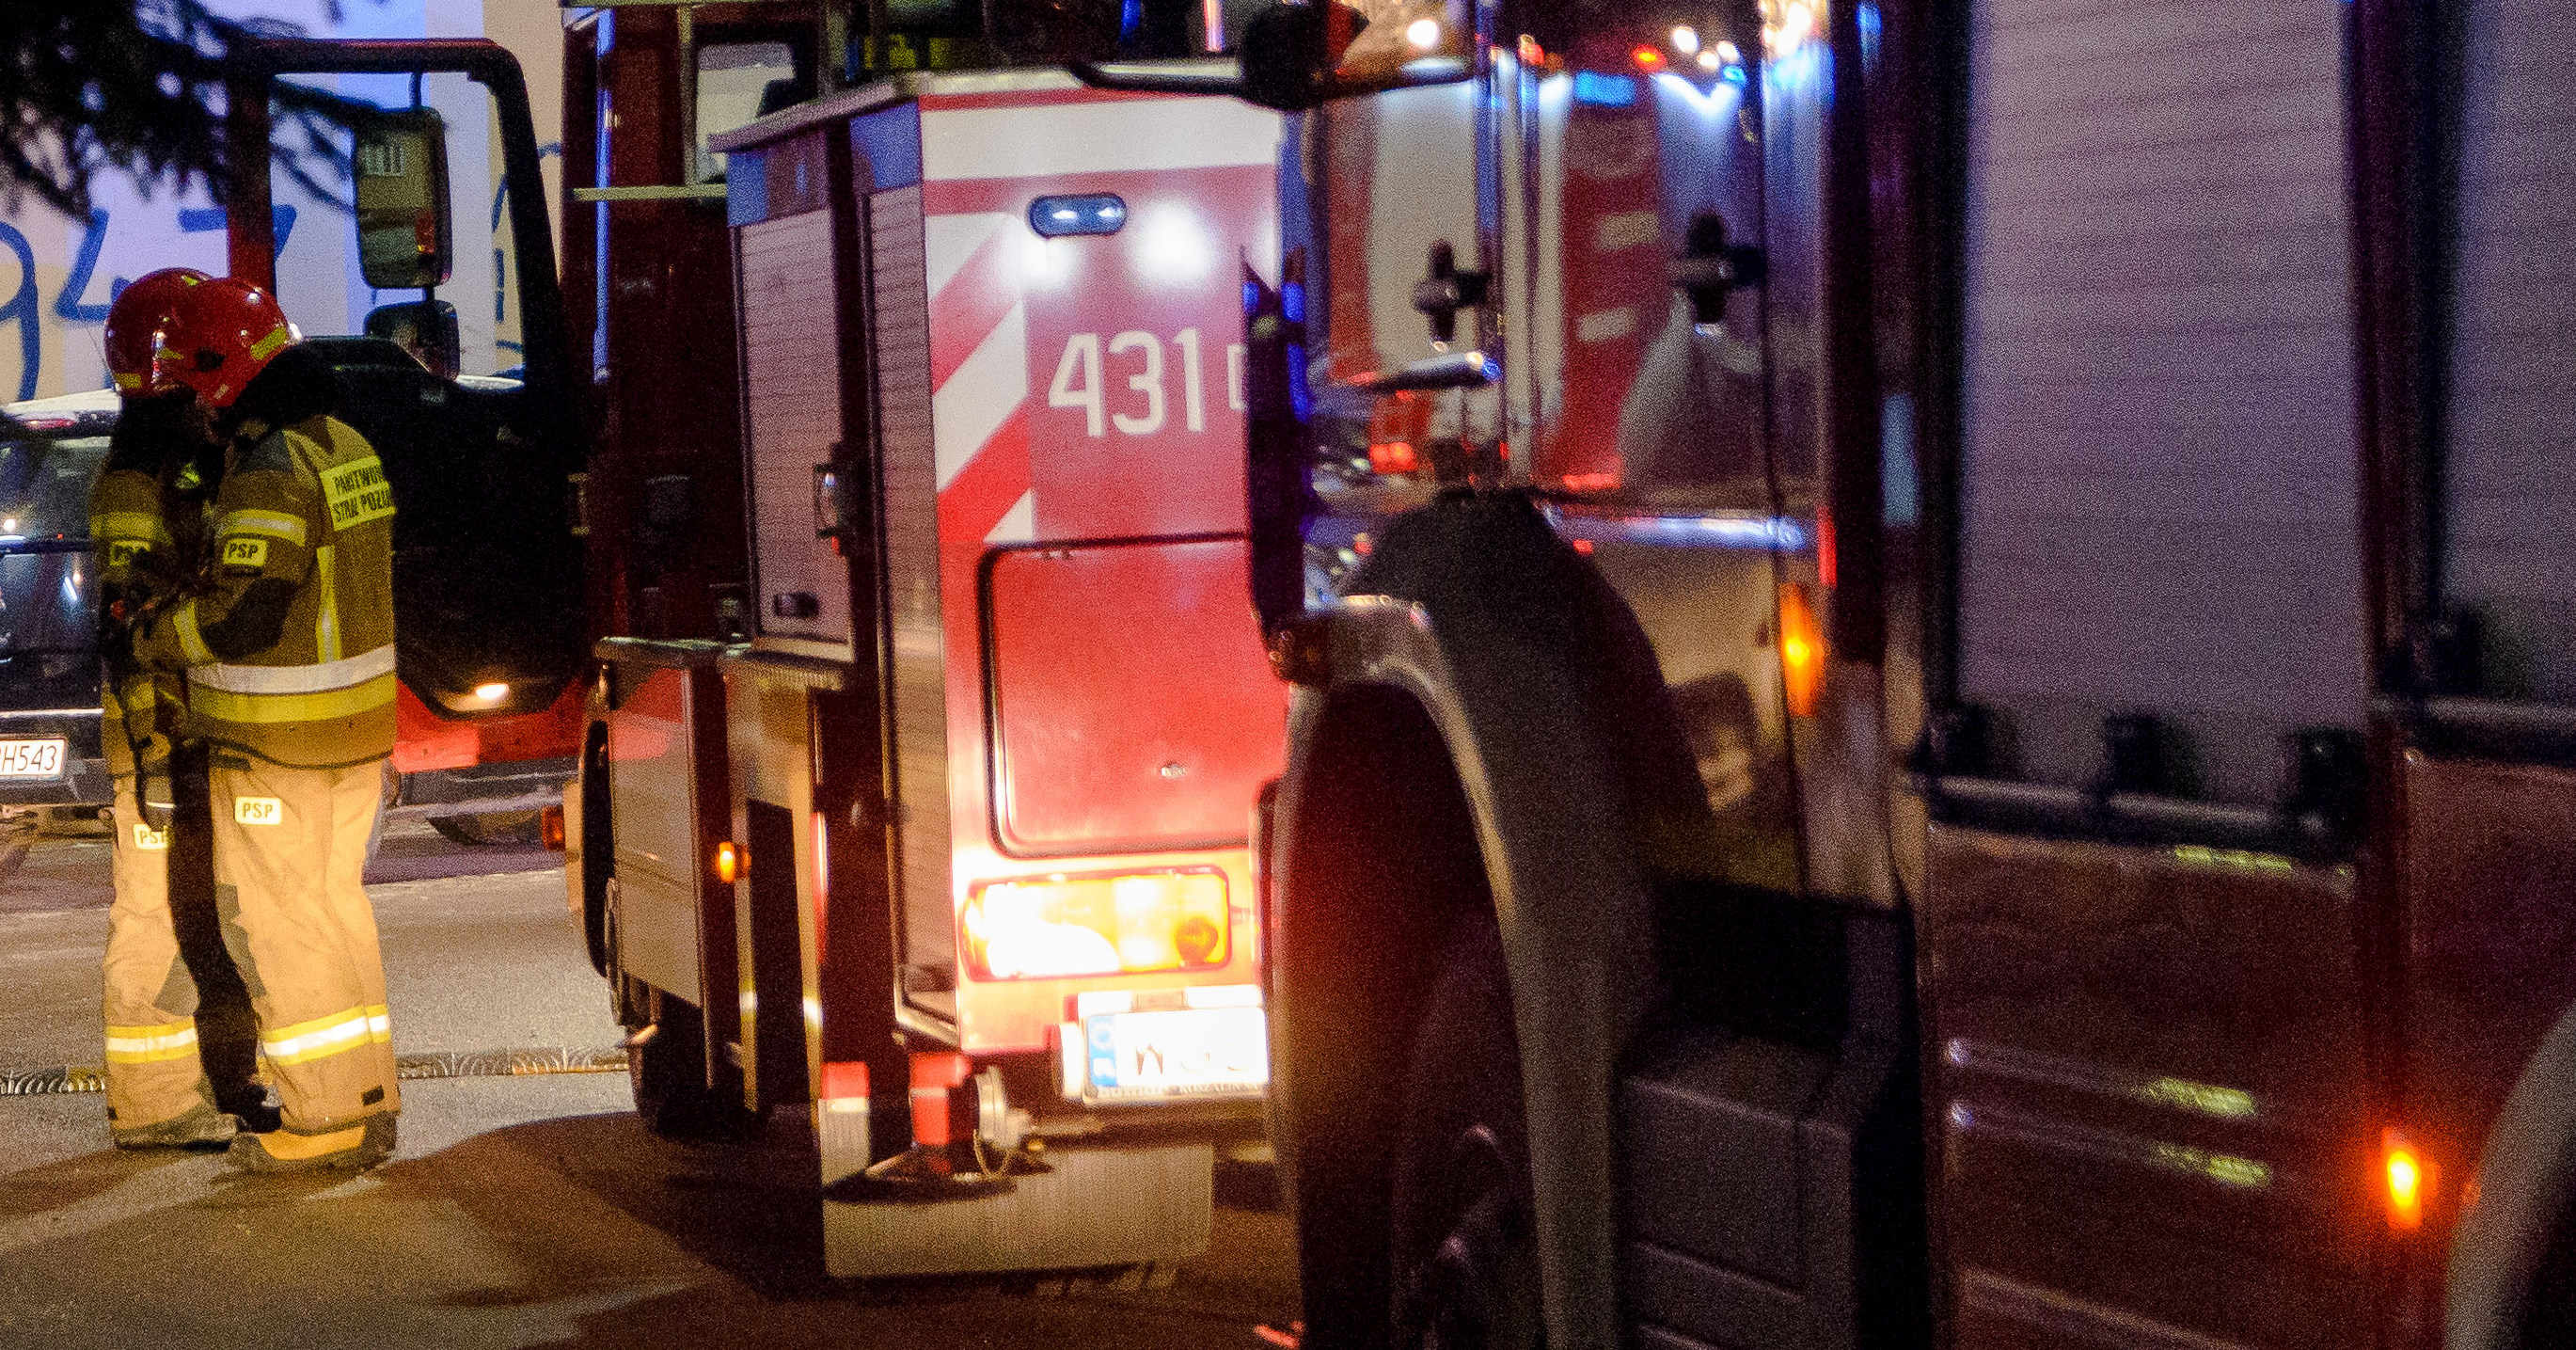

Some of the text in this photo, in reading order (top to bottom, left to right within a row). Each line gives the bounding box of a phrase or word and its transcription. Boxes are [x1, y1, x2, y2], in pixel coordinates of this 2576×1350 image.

[1048, 328, 1205, 438] 431
[229, 543, 259, 559] PSP
[0, 744, 57, 771] H543
[243, 802, 273, 818] PSP
